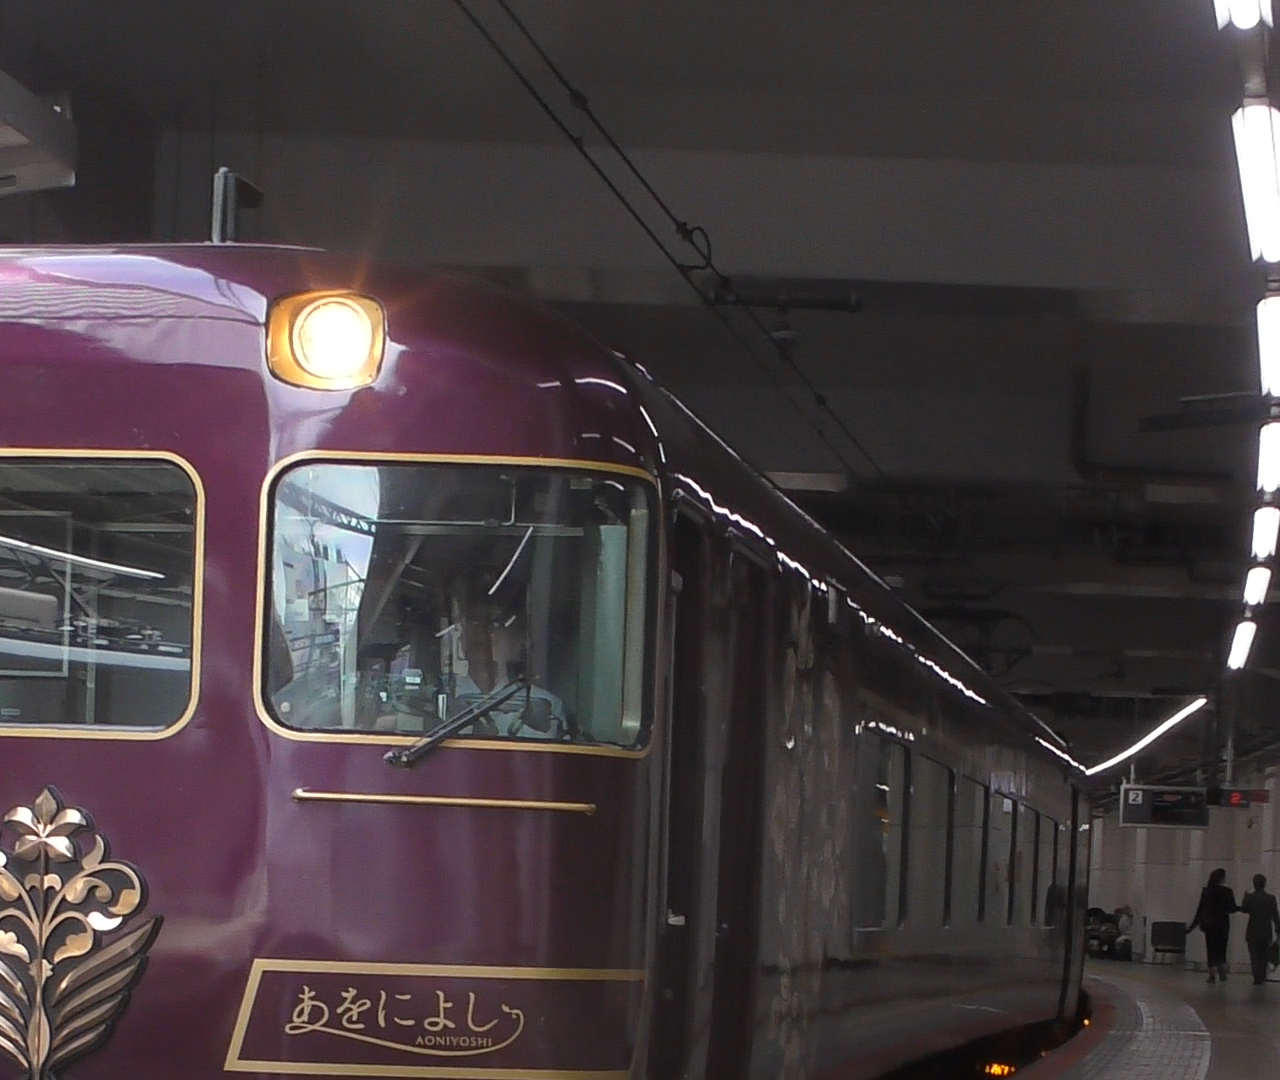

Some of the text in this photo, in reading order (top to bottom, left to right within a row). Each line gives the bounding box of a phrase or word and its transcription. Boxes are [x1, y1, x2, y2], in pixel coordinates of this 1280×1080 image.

[1131, 792, 1140, 803] 2
[286, 984, 510, 1036] あをによし
[415, 1034, 492, 1048] AONIYOSHI
